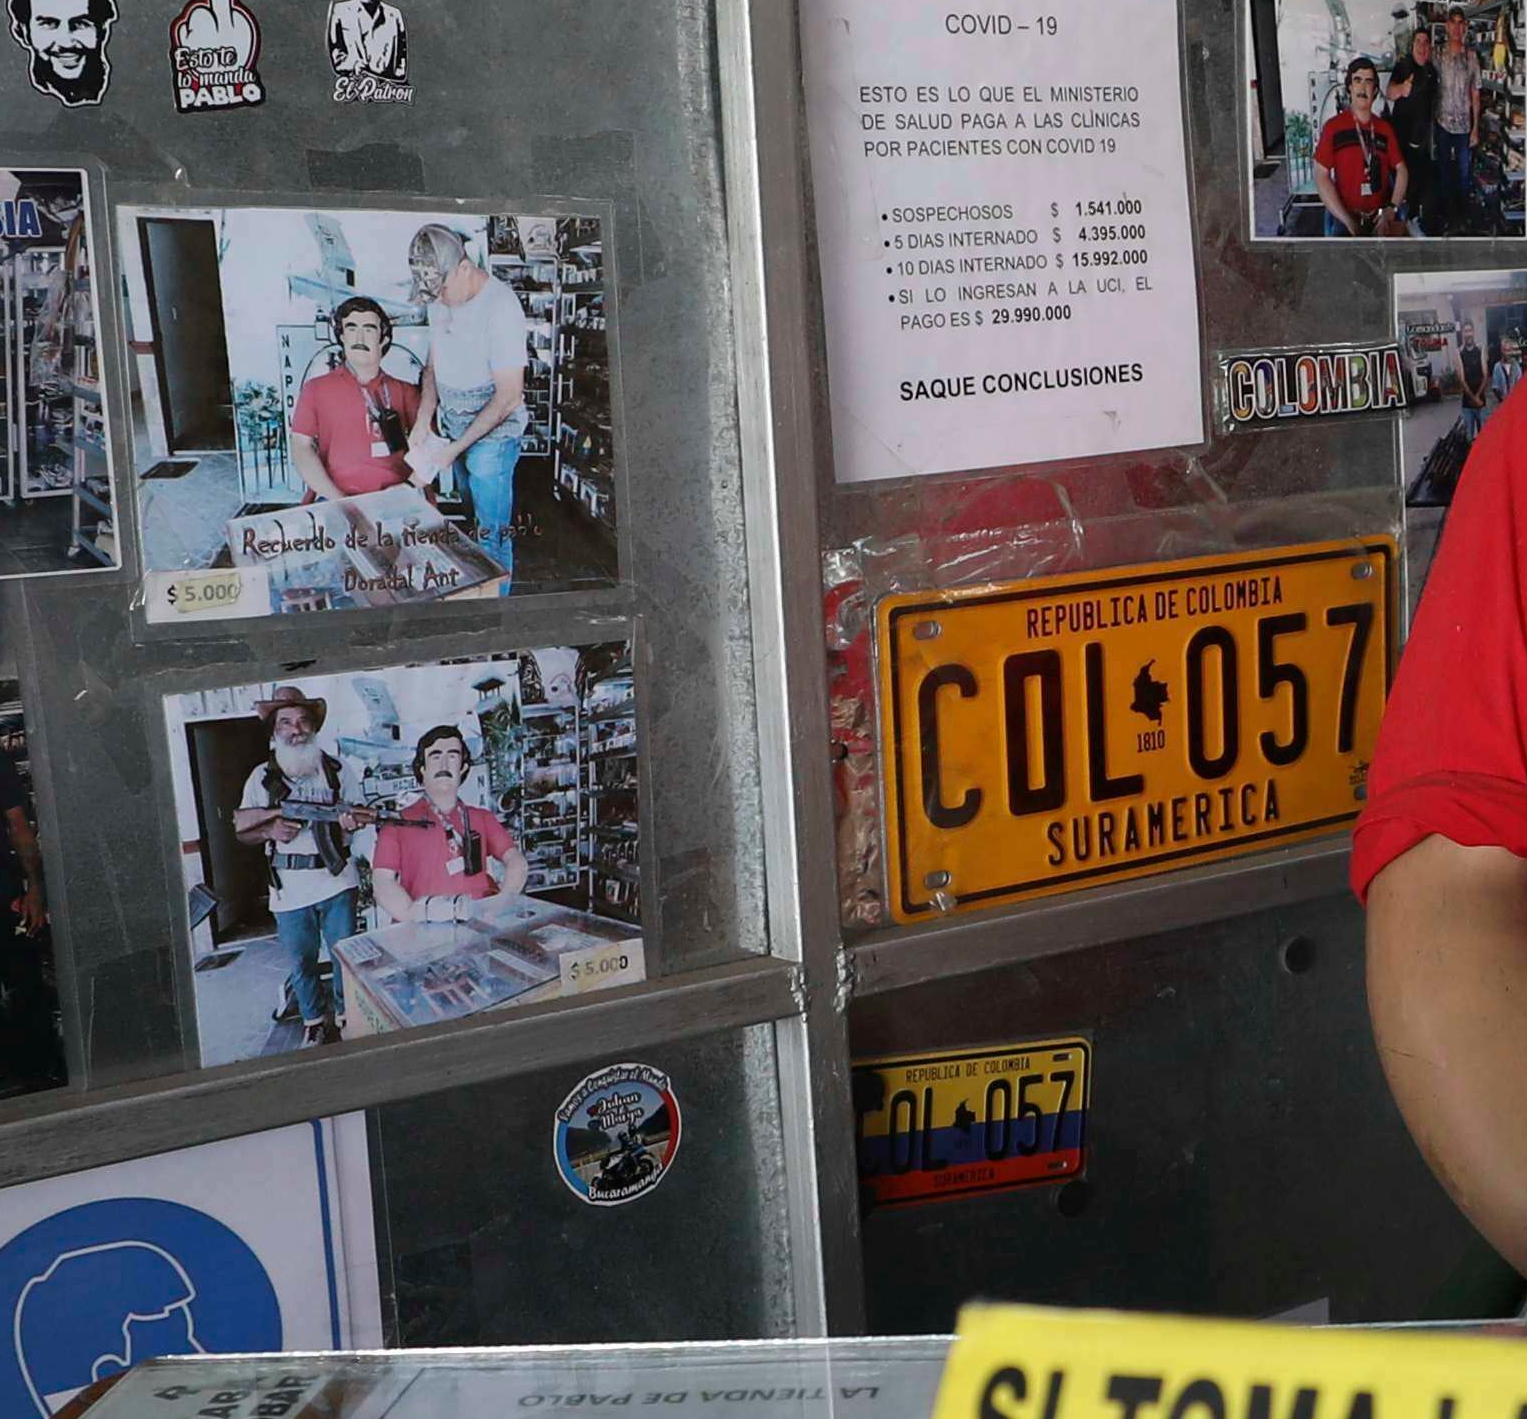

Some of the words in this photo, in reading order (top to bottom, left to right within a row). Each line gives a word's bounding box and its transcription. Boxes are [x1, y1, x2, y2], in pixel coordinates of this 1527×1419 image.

[945, 14, 1012, 35] COVID
[1037, 17, 1057, 35] 19
[179, 84, 262, 108] PABLO
[860, 86, 908, 102] ESTO
[917, 87, 939, 102] ES
[949, 86, 971, 102] LO
[979, 87, 1014, 103] QUE
[1024, 87, 1042, 102] EL
[1051, 86, 1139, 102] MINISTERIO
[892, 205, 1013, 223] SOSPECHOSOS
[1051, 203, 1059, 218] $
[1075, 200, 1142, 216] 1.541.000
[900, 376, 976, 401] SAQUE
[983, 363, 1143, 394] CONCLUSIONES
[1231, 350, 1408, 422] COLOMBIA
[242, 527, 336, 556] Recuerdo
[345, 528, 369, 549] de
[377, 526, 397, 548] la
[402, 517, 459, 547] tienda
[344, 565, 414, 592] Doradal
[422, 560, 460, 587] Ant
[167, 586, 179, 605] $
[185, 583, 240, 602] 5.000
[1027, 595, 1150, 639] REPUBLICA
[1154, 591, 1179, 620] DE
[1186, 576, 1284, 614] COLOMBIA
[917, 640, 1145, 830] COL
[1185, 602, 1379, 781] 057
[1136, 729, 1167, 753] 1810
[1047, 780, 1282, 867] SURAMERICA
